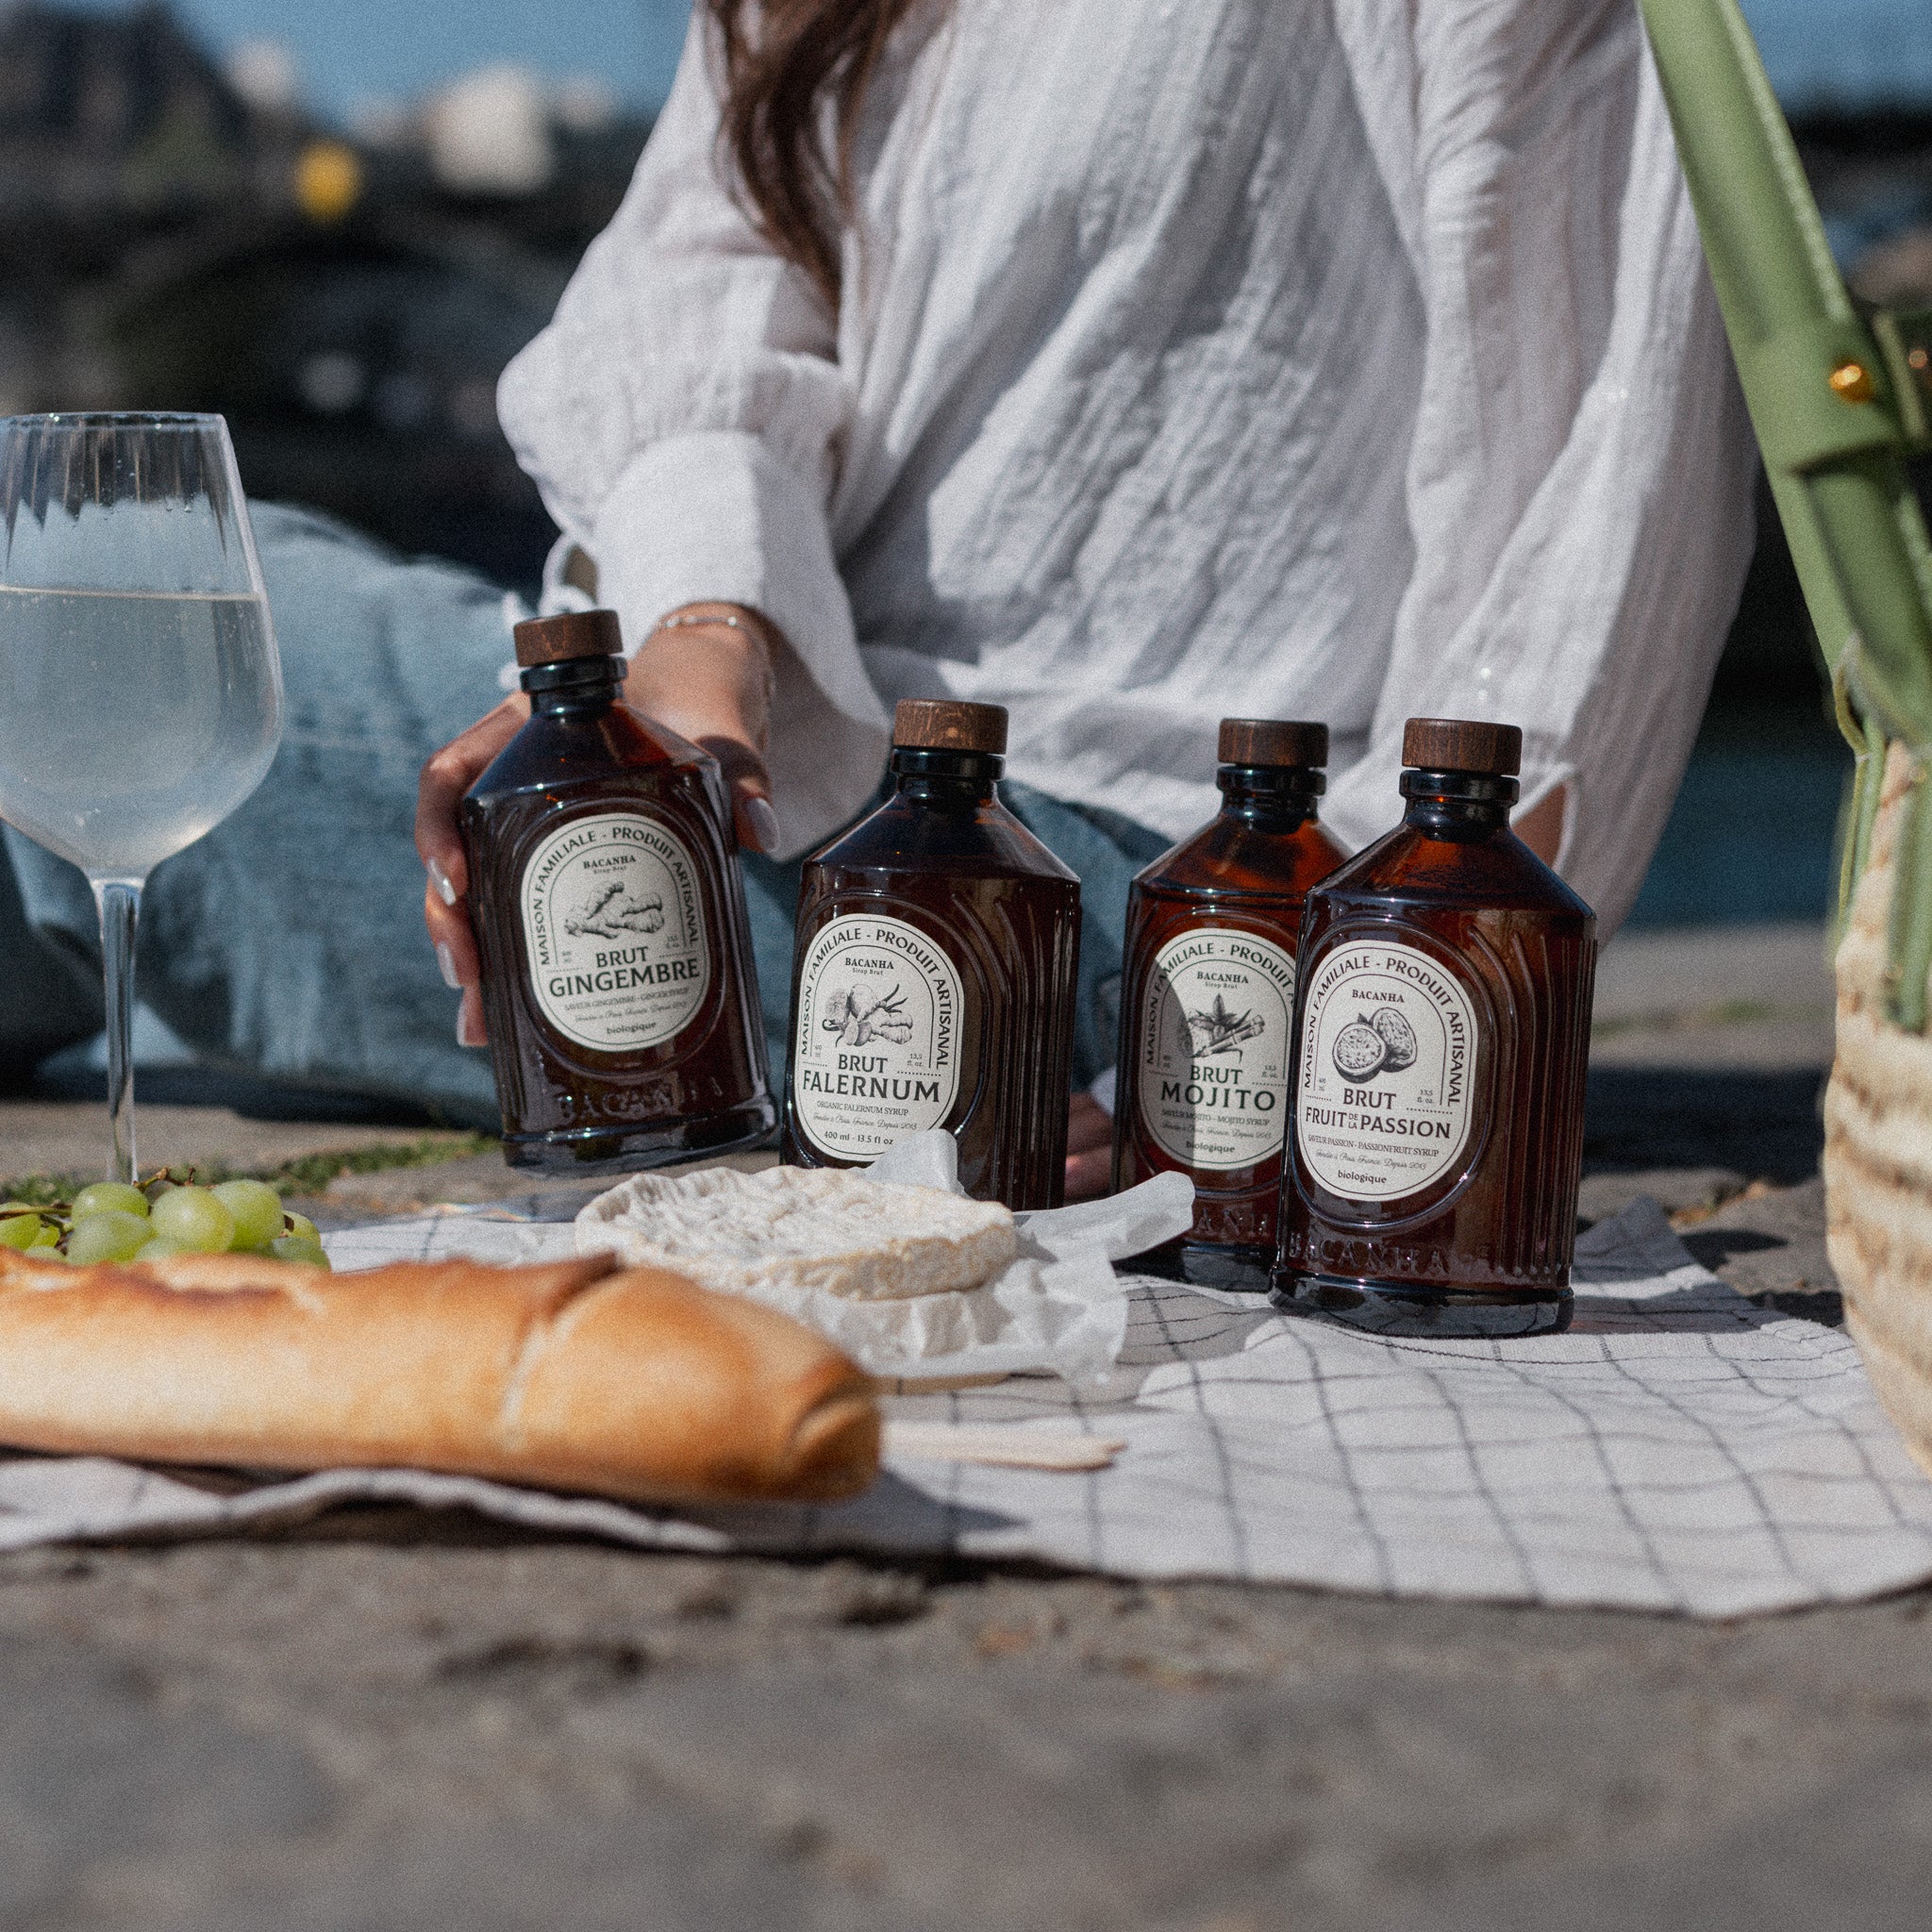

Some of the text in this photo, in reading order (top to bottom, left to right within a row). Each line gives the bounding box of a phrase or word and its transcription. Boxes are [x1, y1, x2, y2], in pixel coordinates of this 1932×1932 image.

[583, 855, 636, 869] BACANHA
[533, 826, 699, 965] MAISON FAMILIALE PRODUIT ARTISANAL
[596, 946, 648, 968] BRUT
[845, 958, 894, 970] BACANHA
[549, 958, 700, 997] GINGEMBRE
[1197, 972, 1249, 984] BACANHA
[801, 928, 952, 1070] MAISON FAMILIALE PRODUIT ARTISANAL
[1146, 943, 1293, 1065] MAISON FAMILIALE PRODUIT
[1352, 990, 1405, 1003] BACANHA
[607, 1021, 657, 1035] biologique
[1304, 955, 1465, 1107] MAISON FAMILIALE PRODUIT ARTISANAL
[838, 1054, 888, 1074] BRUT
[1190, 1065, 1243, 1085] BRUT
[803, 1070, 940, 1102] FALERNUM
[1161, 1082, 1275, 1111] MOJITO
[1343, 1088, 1397, 1109] BRUT
[817, 1100, 908, 1116] ORGANIC FALERNUM SYRUP
[1306, 1107, 1347, 1128] FRUIT
[1360, 1114, 1451, 1139] PASSION
[1348, 1122, 1357, 1130] LA
[824, 1130, 838, 1140] 400
[840, 1132, 849, 1141] ml
[858, 1134, 872, 1143] 13.5
[874, 1136, 881, 1144] fl
[1186, 1141, 1236, 1153] biologique
[1327, 1138, 1354, 1148] PASSION
[1358, 1141, 1413, 1155] PASSIONFRUIT
[1413, 1147, 1440, 1158] SYRUP
[1338, 1170, 1387, 1185] biologique
